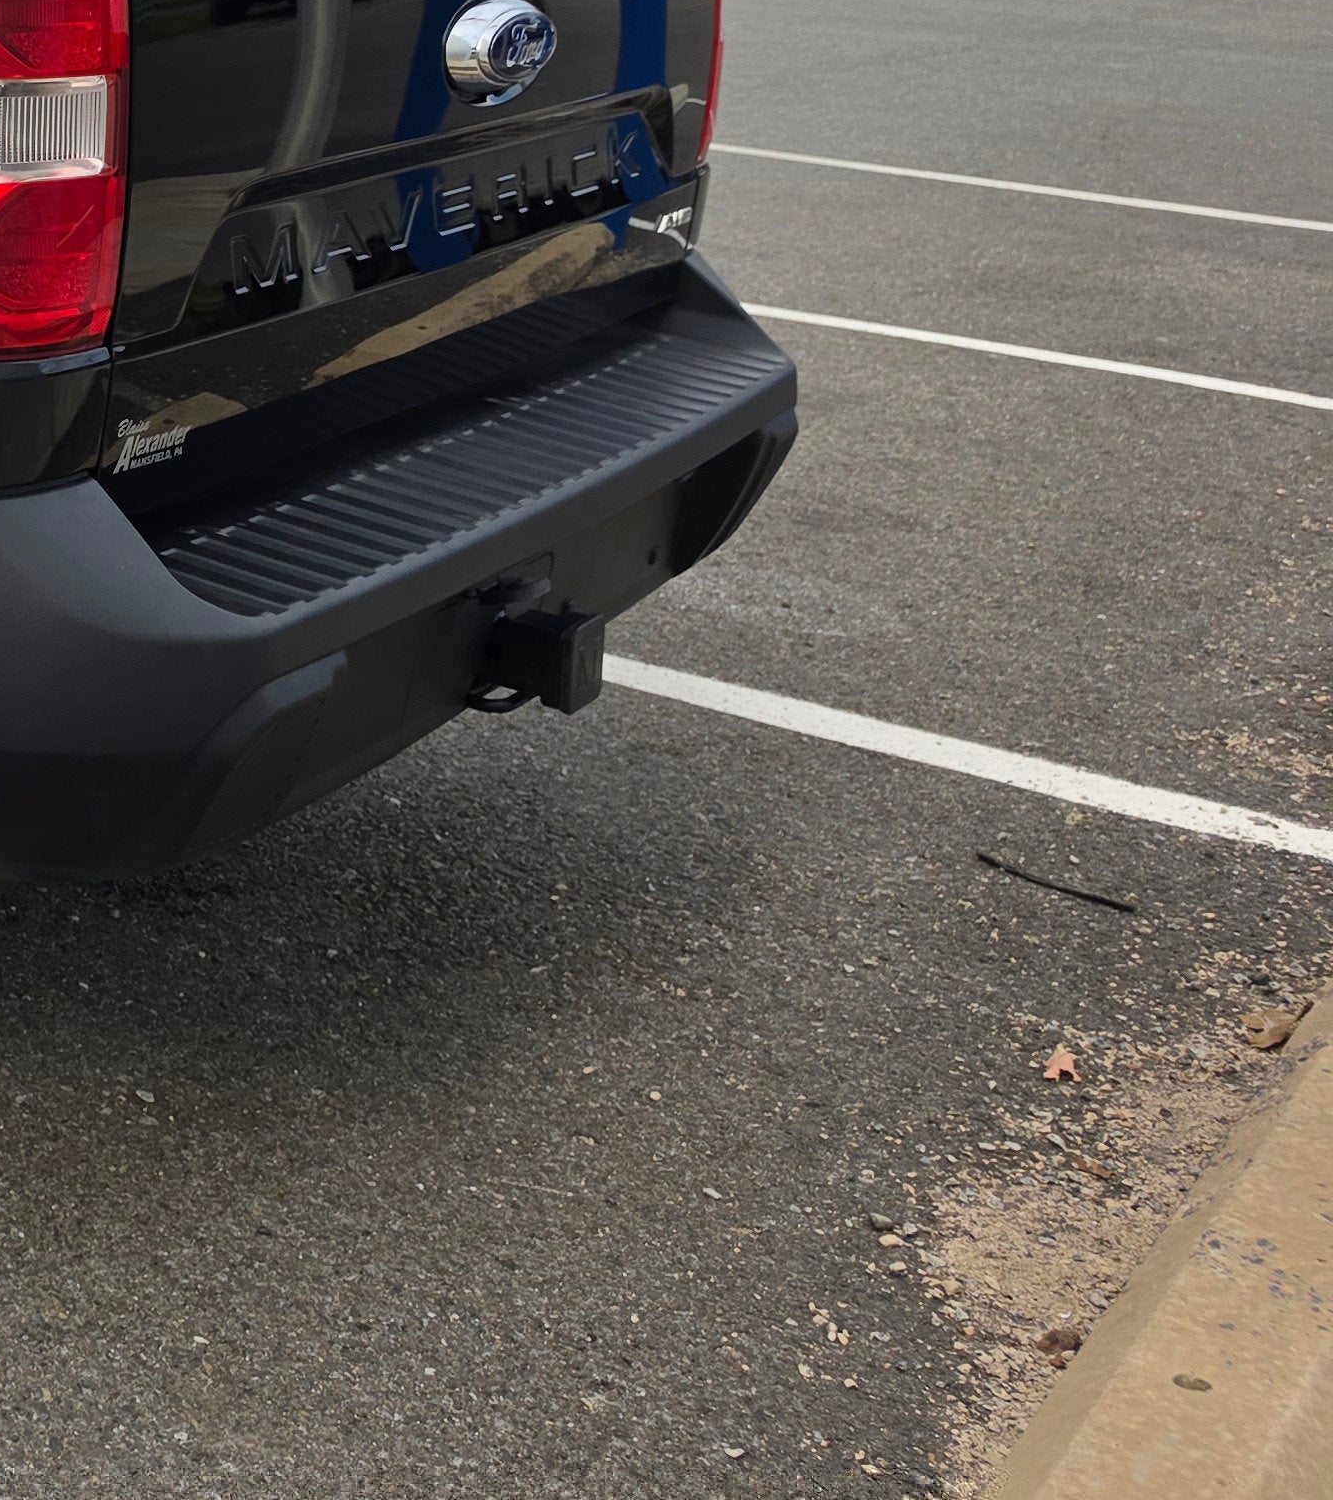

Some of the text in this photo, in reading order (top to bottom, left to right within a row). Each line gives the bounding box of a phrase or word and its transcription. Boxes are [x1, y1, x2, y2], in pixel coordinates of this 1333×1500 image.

[507, 19, 548, 67] Ford
[230, 128, 641, 295] MAVERICK
[113, 424, 193, 475] Alexander
